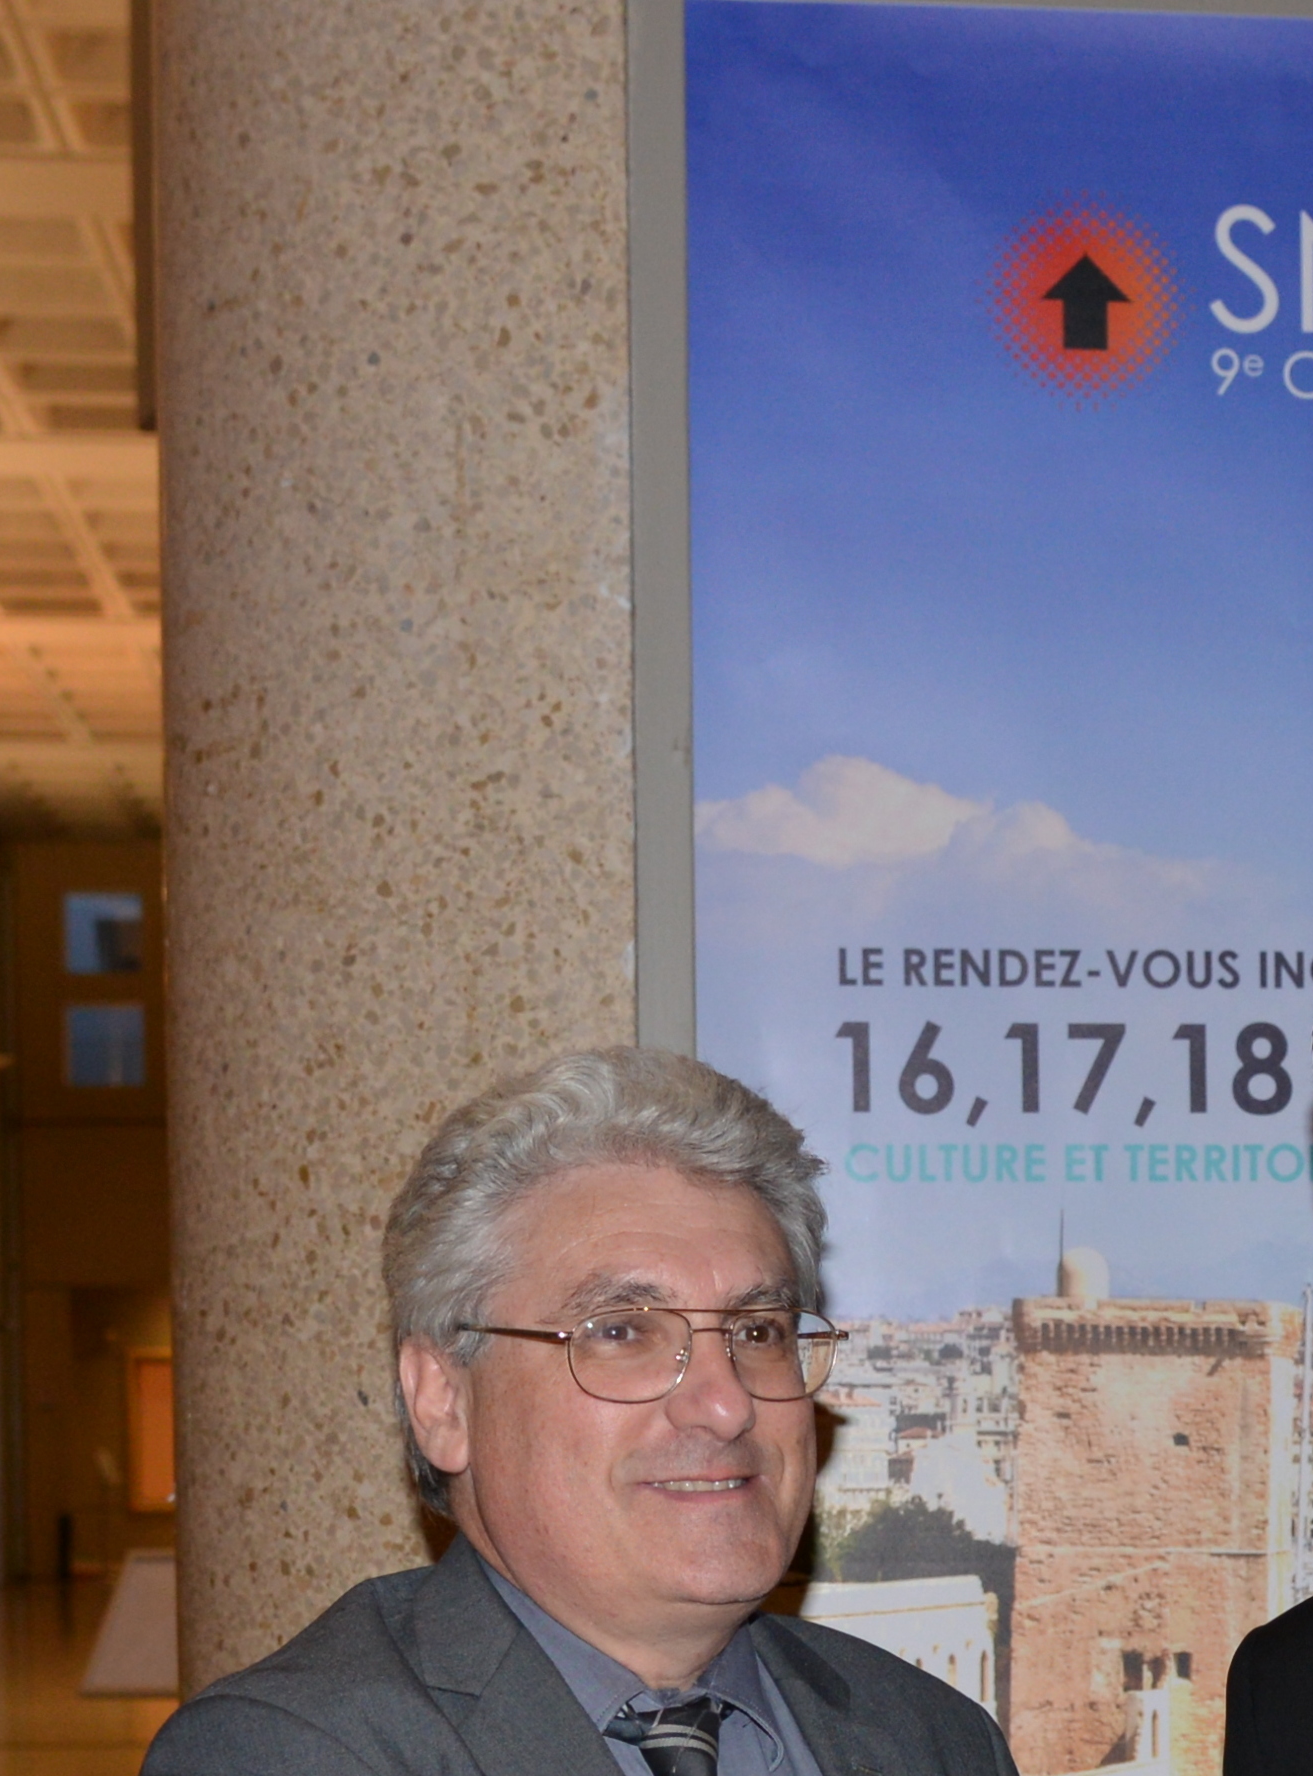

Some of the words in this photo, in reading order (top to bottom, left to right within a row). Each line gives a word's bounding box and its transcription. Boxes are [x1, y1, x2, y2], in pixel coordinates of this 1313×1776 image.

[838, 947, 884, 986] LE
[903, 948, 1241, 990] RENDEZ-VOUS
[844, 1142, 1047, 1183] CULTURE
[1065, 1143, 1110, 1183] ET
